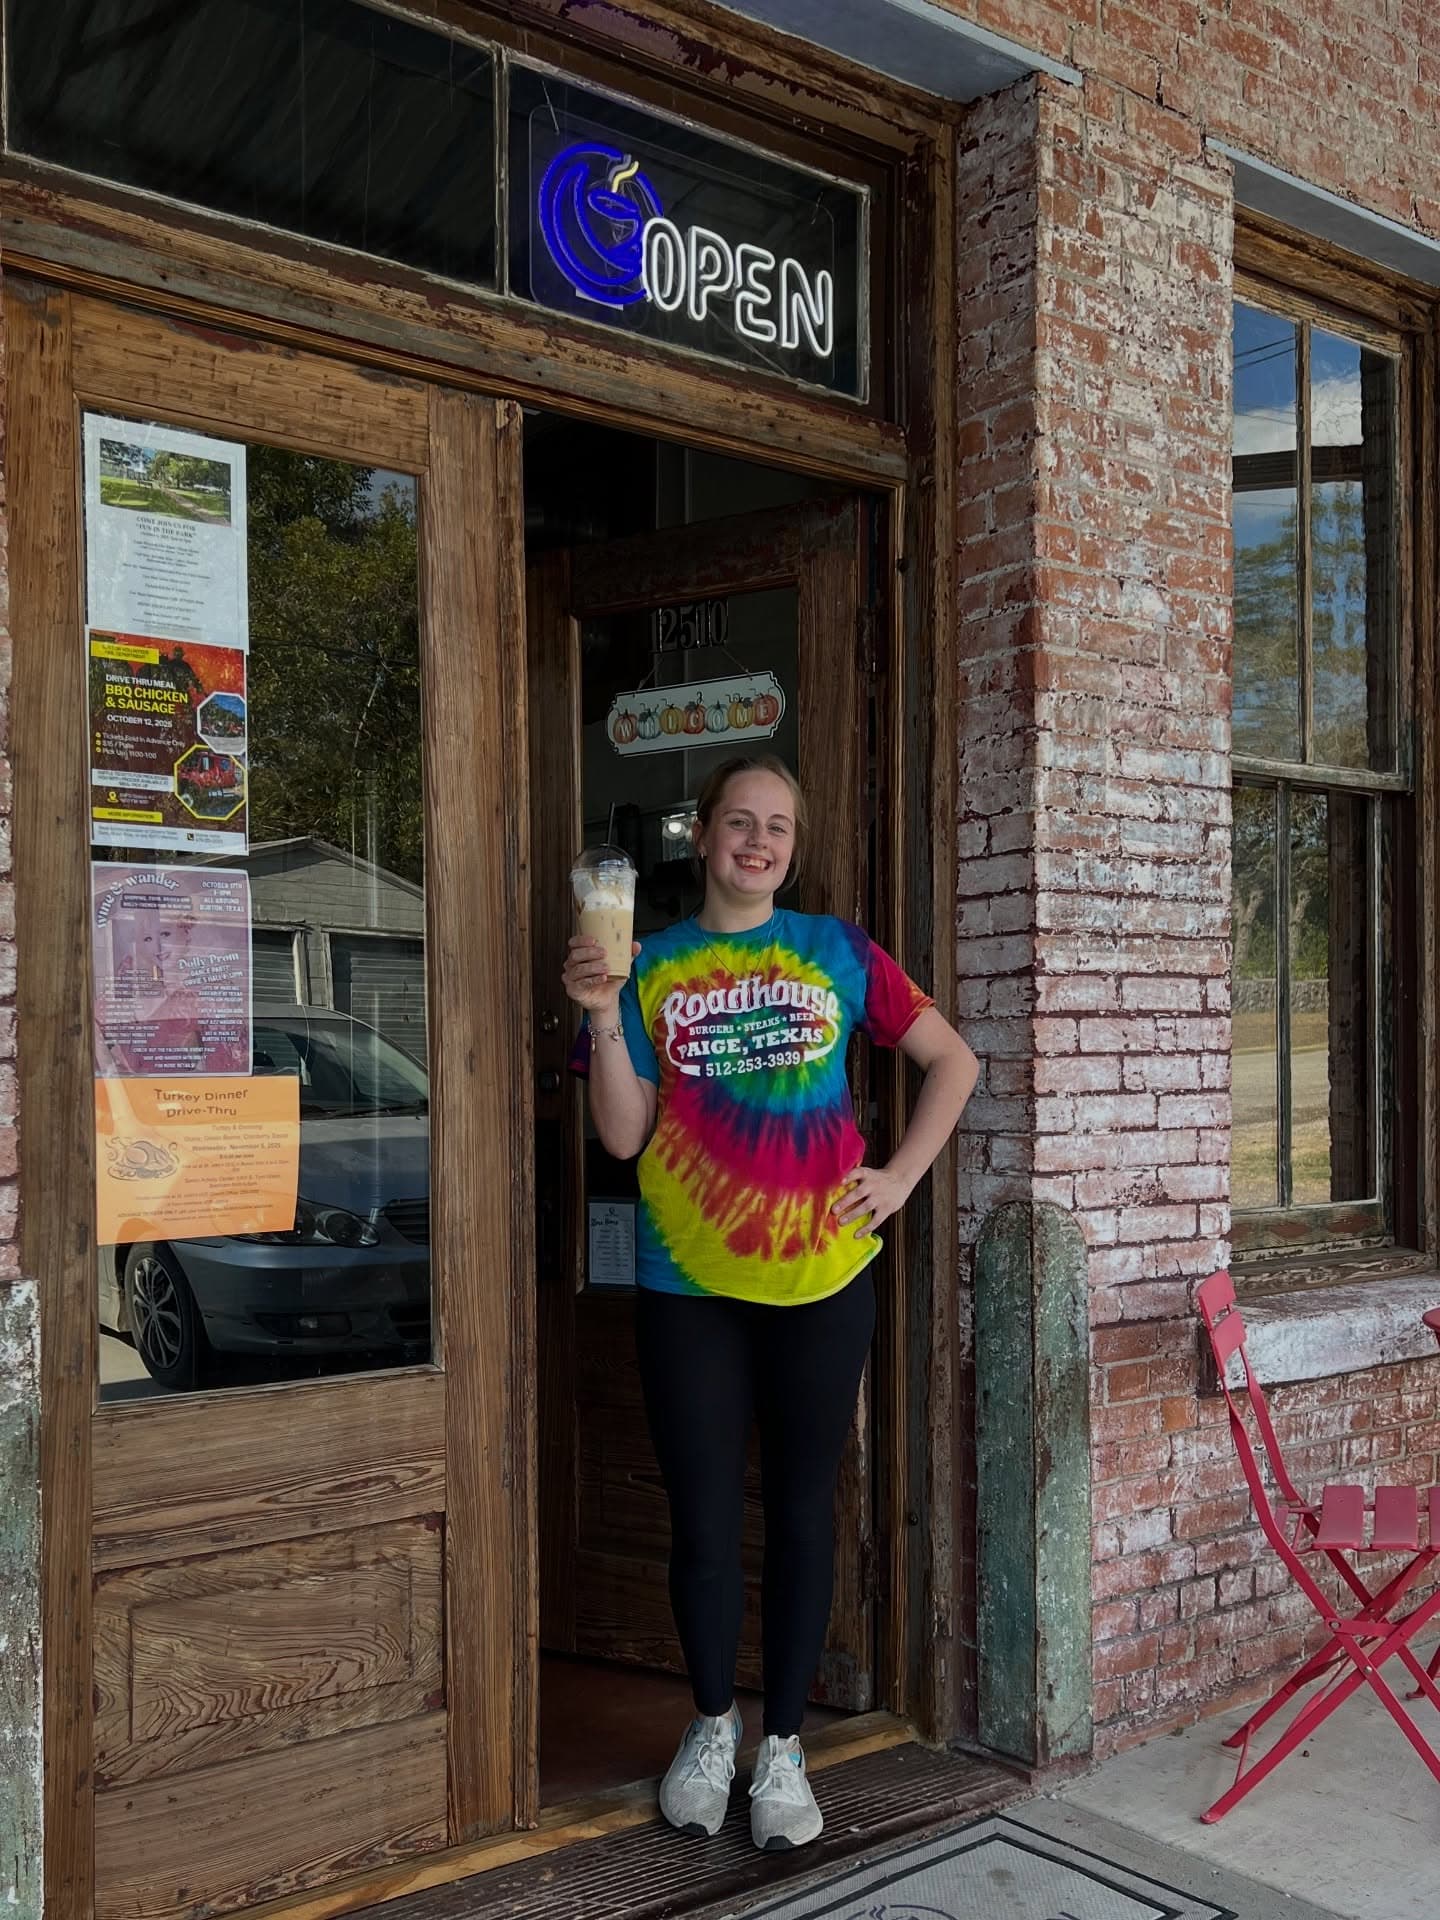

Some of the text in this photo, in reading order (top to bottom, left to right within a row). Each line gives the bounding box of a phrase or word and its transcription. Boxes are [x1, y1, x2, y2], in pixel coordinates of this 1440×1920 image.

[641, 216, 833, 357] OPEN
[650, 599, 729, 653] 12510
[106, 674, 176, 690] DRIVE THRU MEAL
[106, 684, 188, 704] BBQ CHICKEN
[106, 696, 176, 714] & SAUSAGE
[106, 714, 143, 724] OCTOBER
[177, 953, 240, 970] Dolly Prom
[688, 1012, 816, 1036] BURGERS STEAKS BEER
[677, 1027, 824, 1060] PAIGE, TEXAS
[706, 1051, 800, 1077] 512-253-3939
[154, 1088, 249, 1102] Turkey Dinner
[166, 1105, 238, 1118] Drive-Thru
